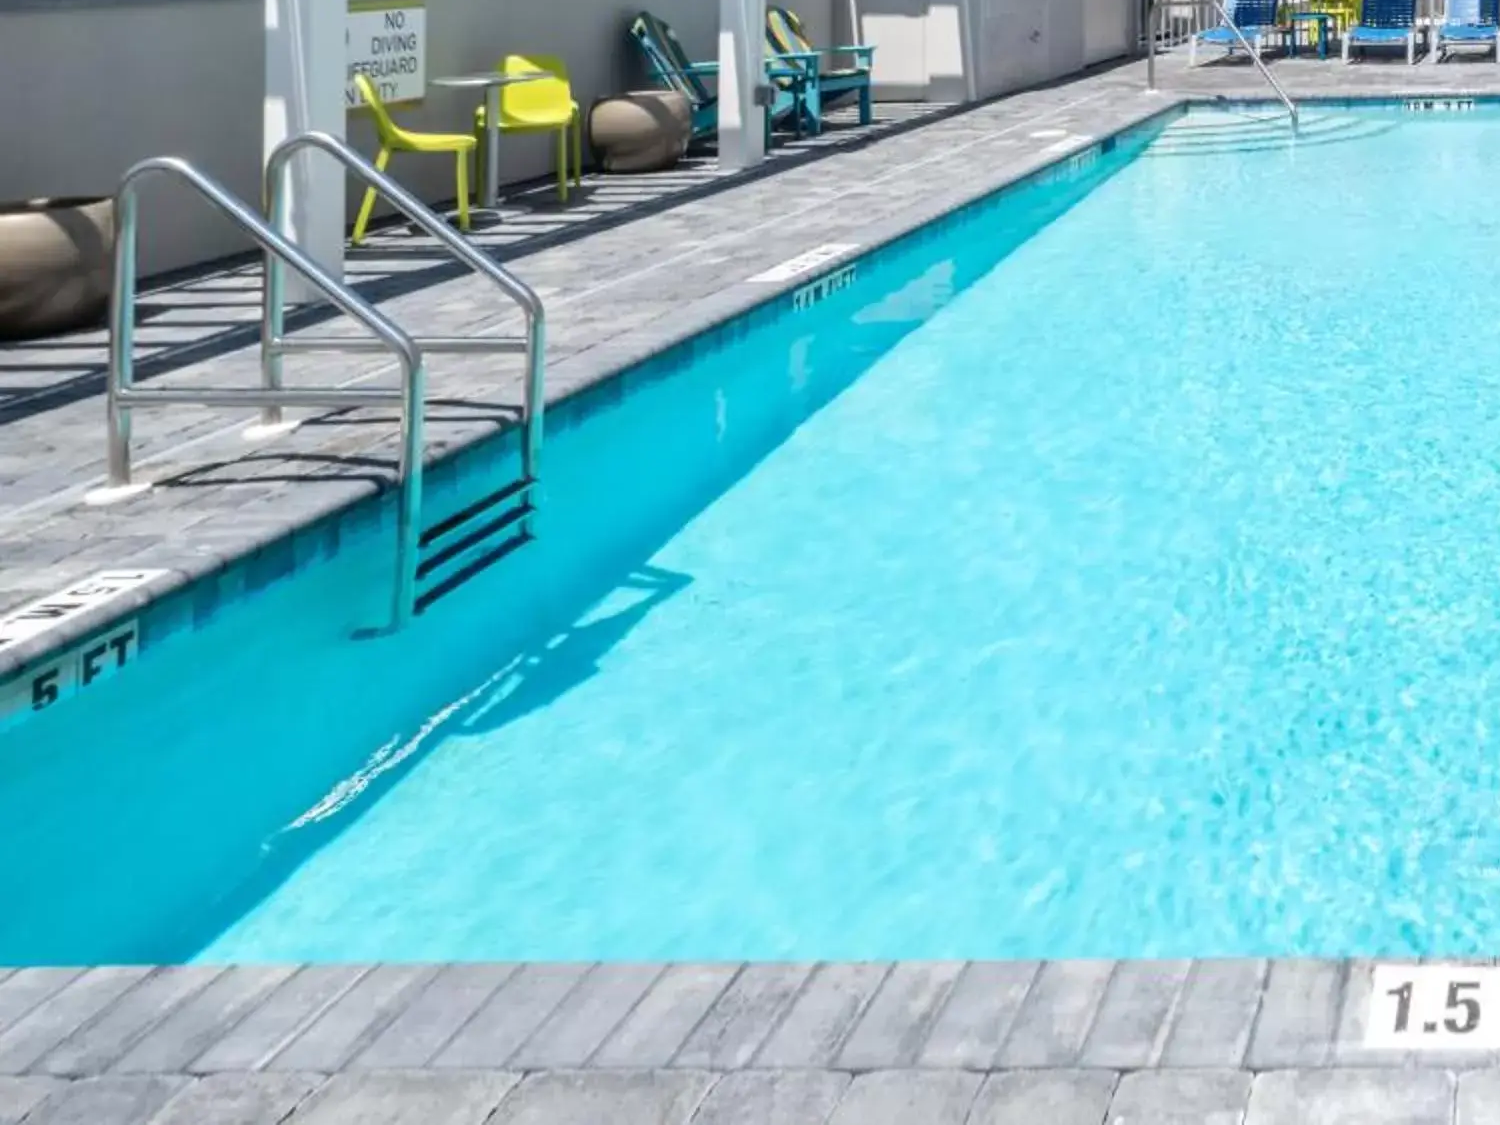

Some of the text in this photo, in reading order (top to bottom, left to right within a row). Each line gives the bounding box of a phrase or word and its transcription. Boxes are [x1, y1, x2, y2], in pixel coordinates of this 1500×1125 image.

[385, 11, 406, 30] NO
[371, 32, 417, 55] DIVING
[31, 629, 135, 712] 5 FT
[1386, 980, 1482, 1034] 1.5
